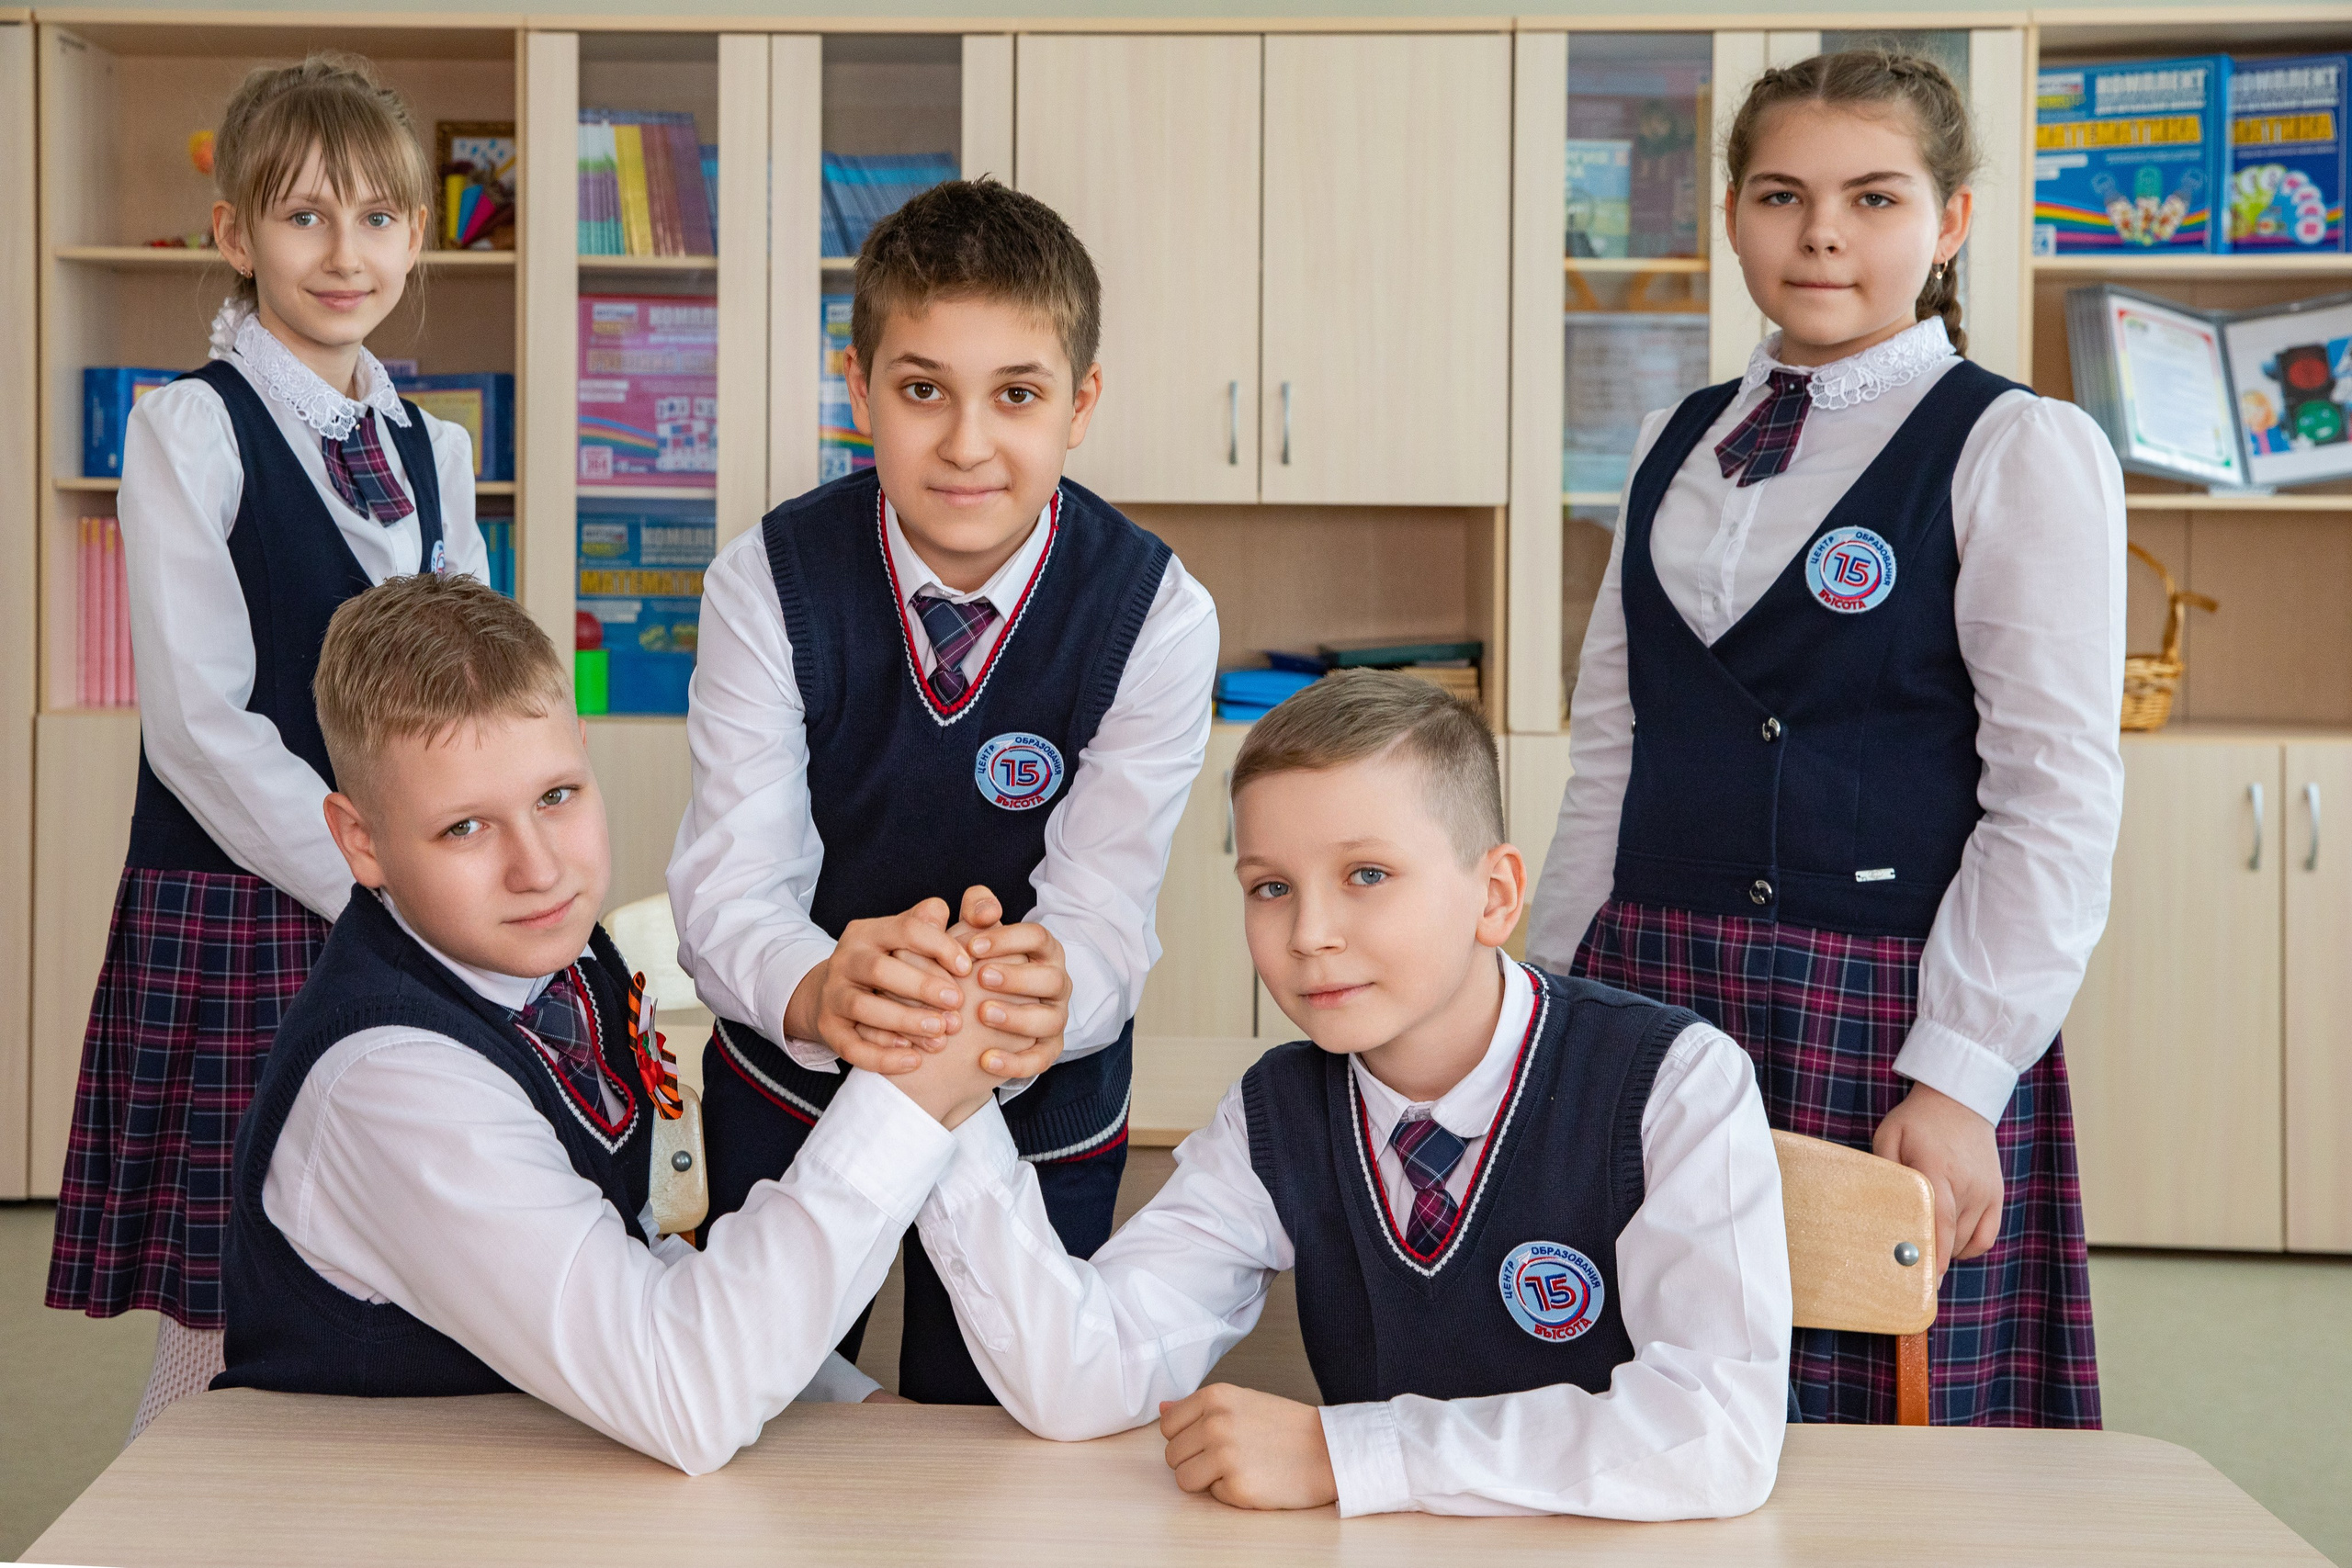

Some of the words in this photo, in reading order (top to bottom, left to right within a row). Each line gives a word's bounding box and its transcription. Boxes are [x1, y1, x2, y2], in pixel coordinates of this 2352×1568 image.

[1810, 536, 1834, 564] ЦЕНТР
[1855, 531, 1893, 586] ОБРАЗОВАНИЯ
[1834, 552, 1871, 587] 15
[1818, 589, 1866, 610] ВЫСОТА
[978, 744, 995, 773] ЦЕНТР
[1014, 737, 1061, 774] ОБРАЗОВАНИЯ
[1000, 759, 1040, 786] 15
[995, 795, 1046, 808] ВЫСОТА
[1503, 1260, 1514, 1299] ЦЕНТР
[1531, 1247, 1600, 1289] ОБРАЗОВАНИЯ
[1524, 1273, 1577, 1312] 15
[1534, 1317, 1592, 1340] ВЫСОТА
